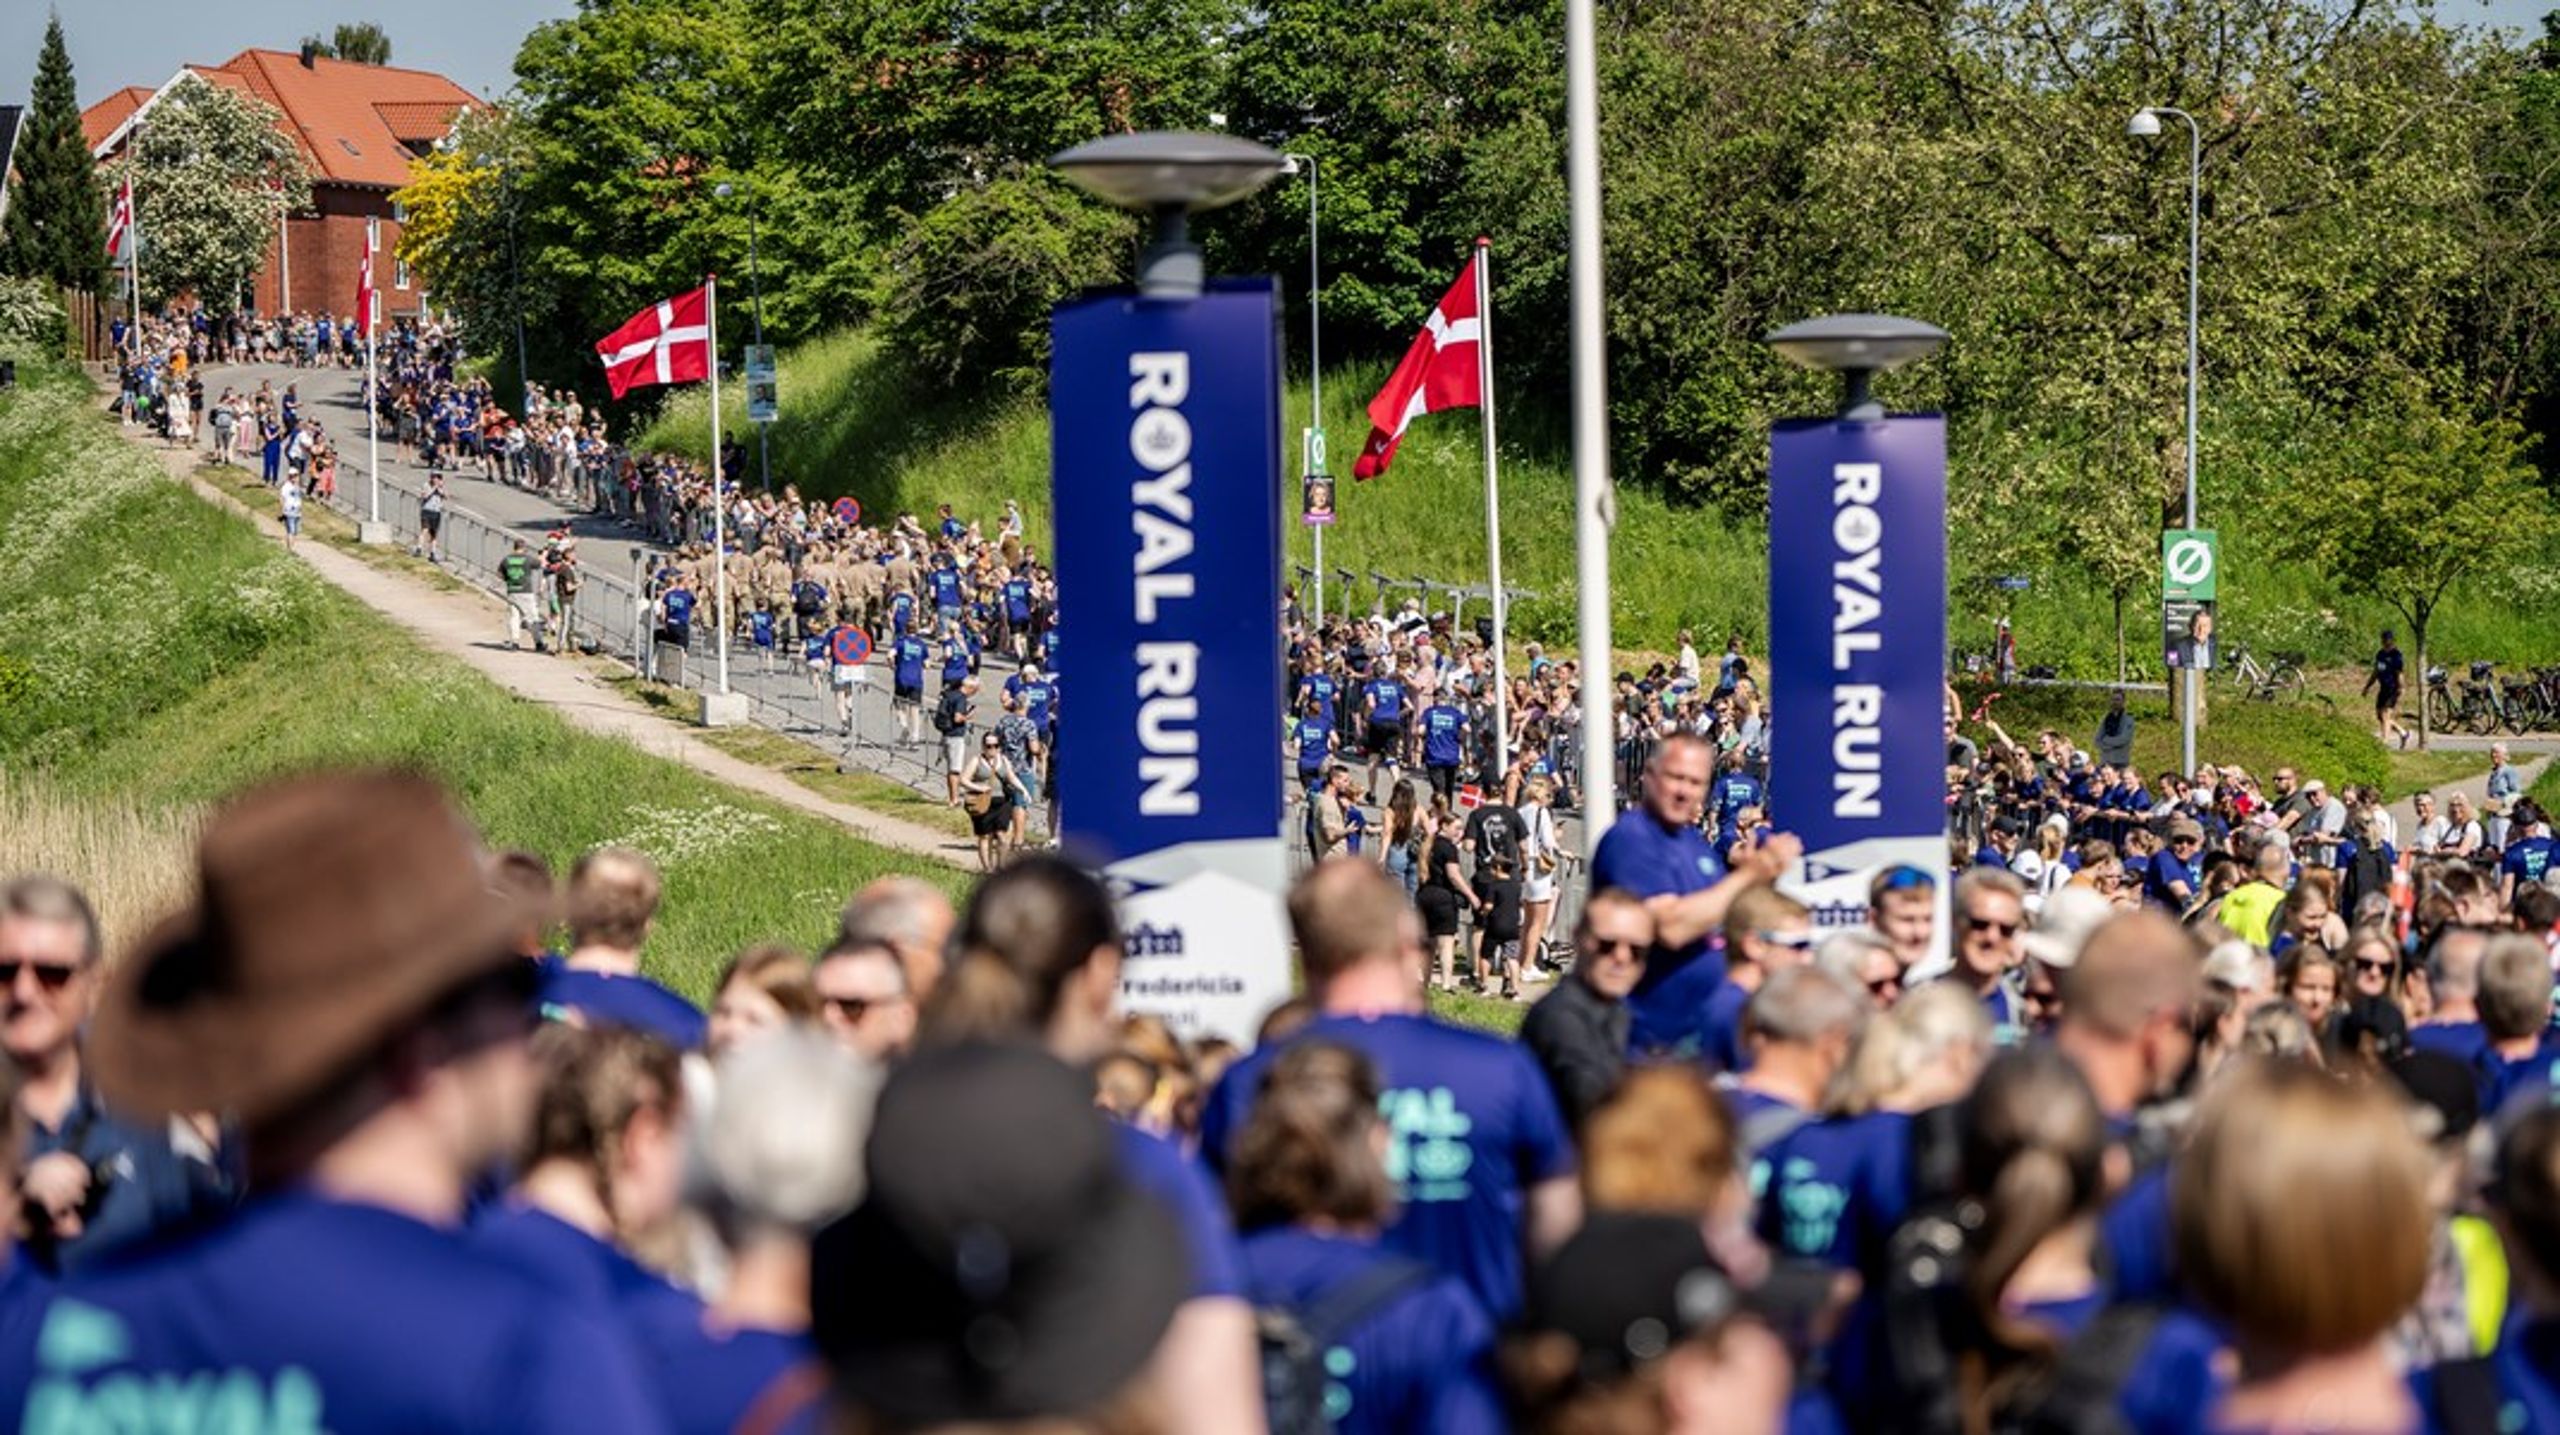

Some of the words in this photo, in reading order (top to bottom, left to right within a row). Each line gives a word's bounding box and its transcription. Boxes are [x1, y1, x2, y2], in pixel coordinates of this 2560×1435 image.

[1130, 352, 1194, 622] ROYAL
[1833, 463, 1882, 669] ROYAL
[1137, 642, 1199, 815] RUN
[1833, 684, 1884, 817] RUN
[1113, 974, 1244, 996] redericia
